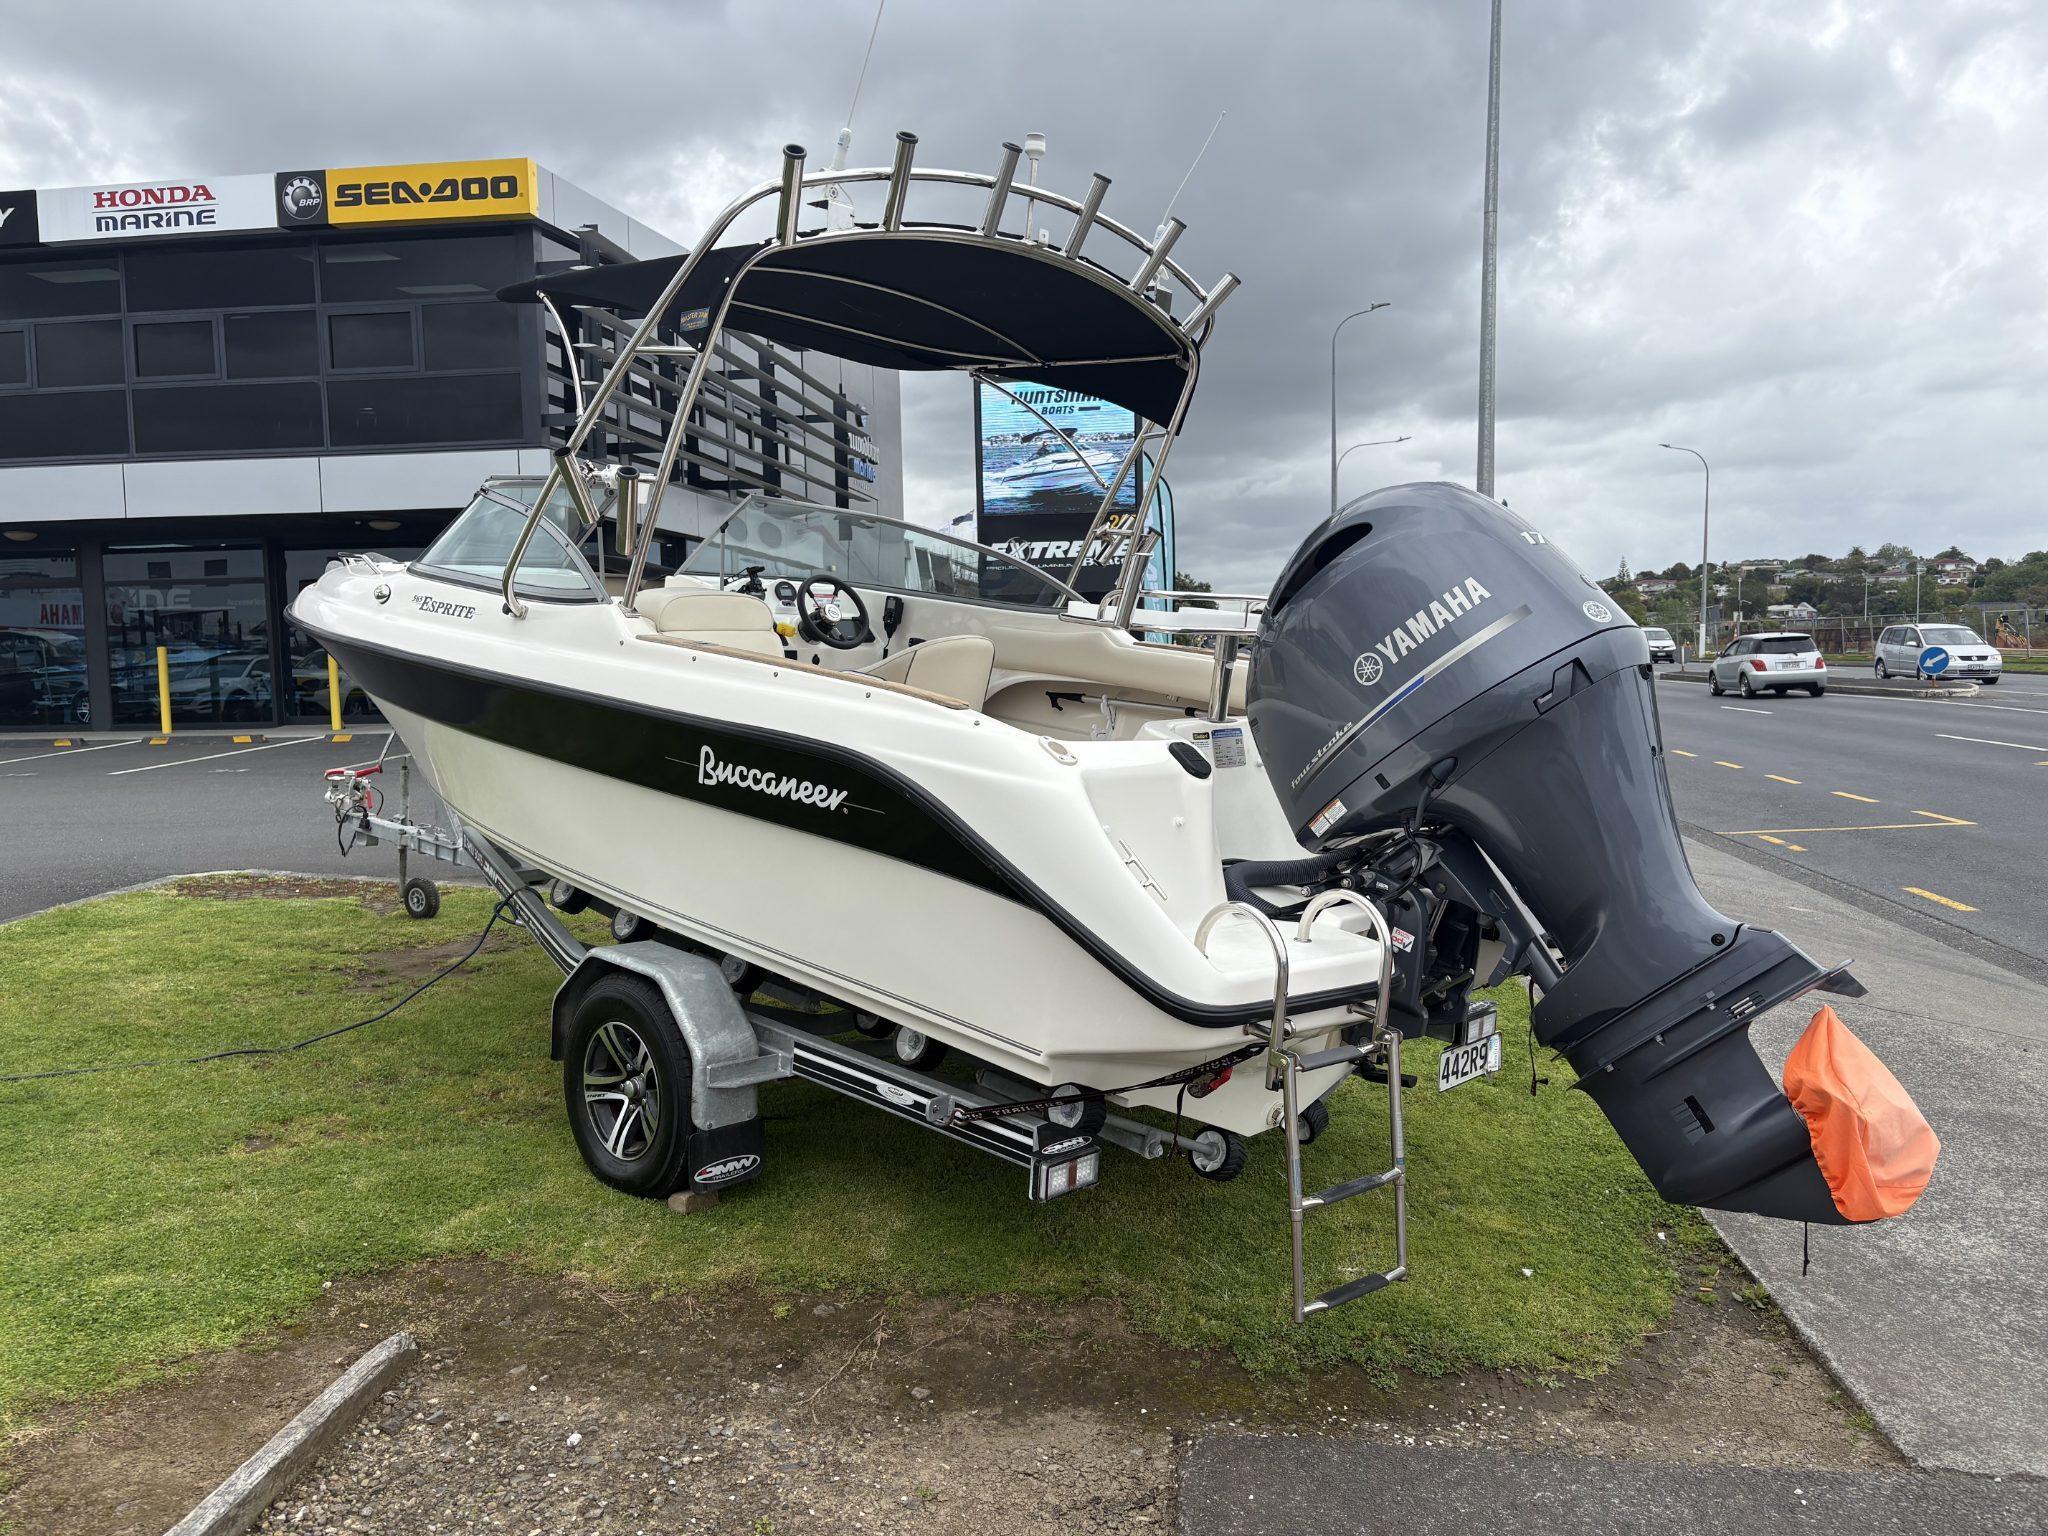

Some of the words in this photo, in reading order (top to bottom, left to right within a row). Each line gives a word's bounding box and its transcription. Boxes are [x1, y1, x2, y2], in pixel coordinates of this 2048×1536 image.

[92, 184, 216, 209] HONDA
[299, 198, 320, 207] BRP
[96, 208, 216, 232] MARINE
[1041, 405, 1075, 415] BOATS
[418, 596, 476, 619] ESPRITE
[1375, 577, 1492, 664] YAMAHA
[698, 744, 848, 811] Buccaneer
[1441, 1042, 1488, 1084] 442R9
